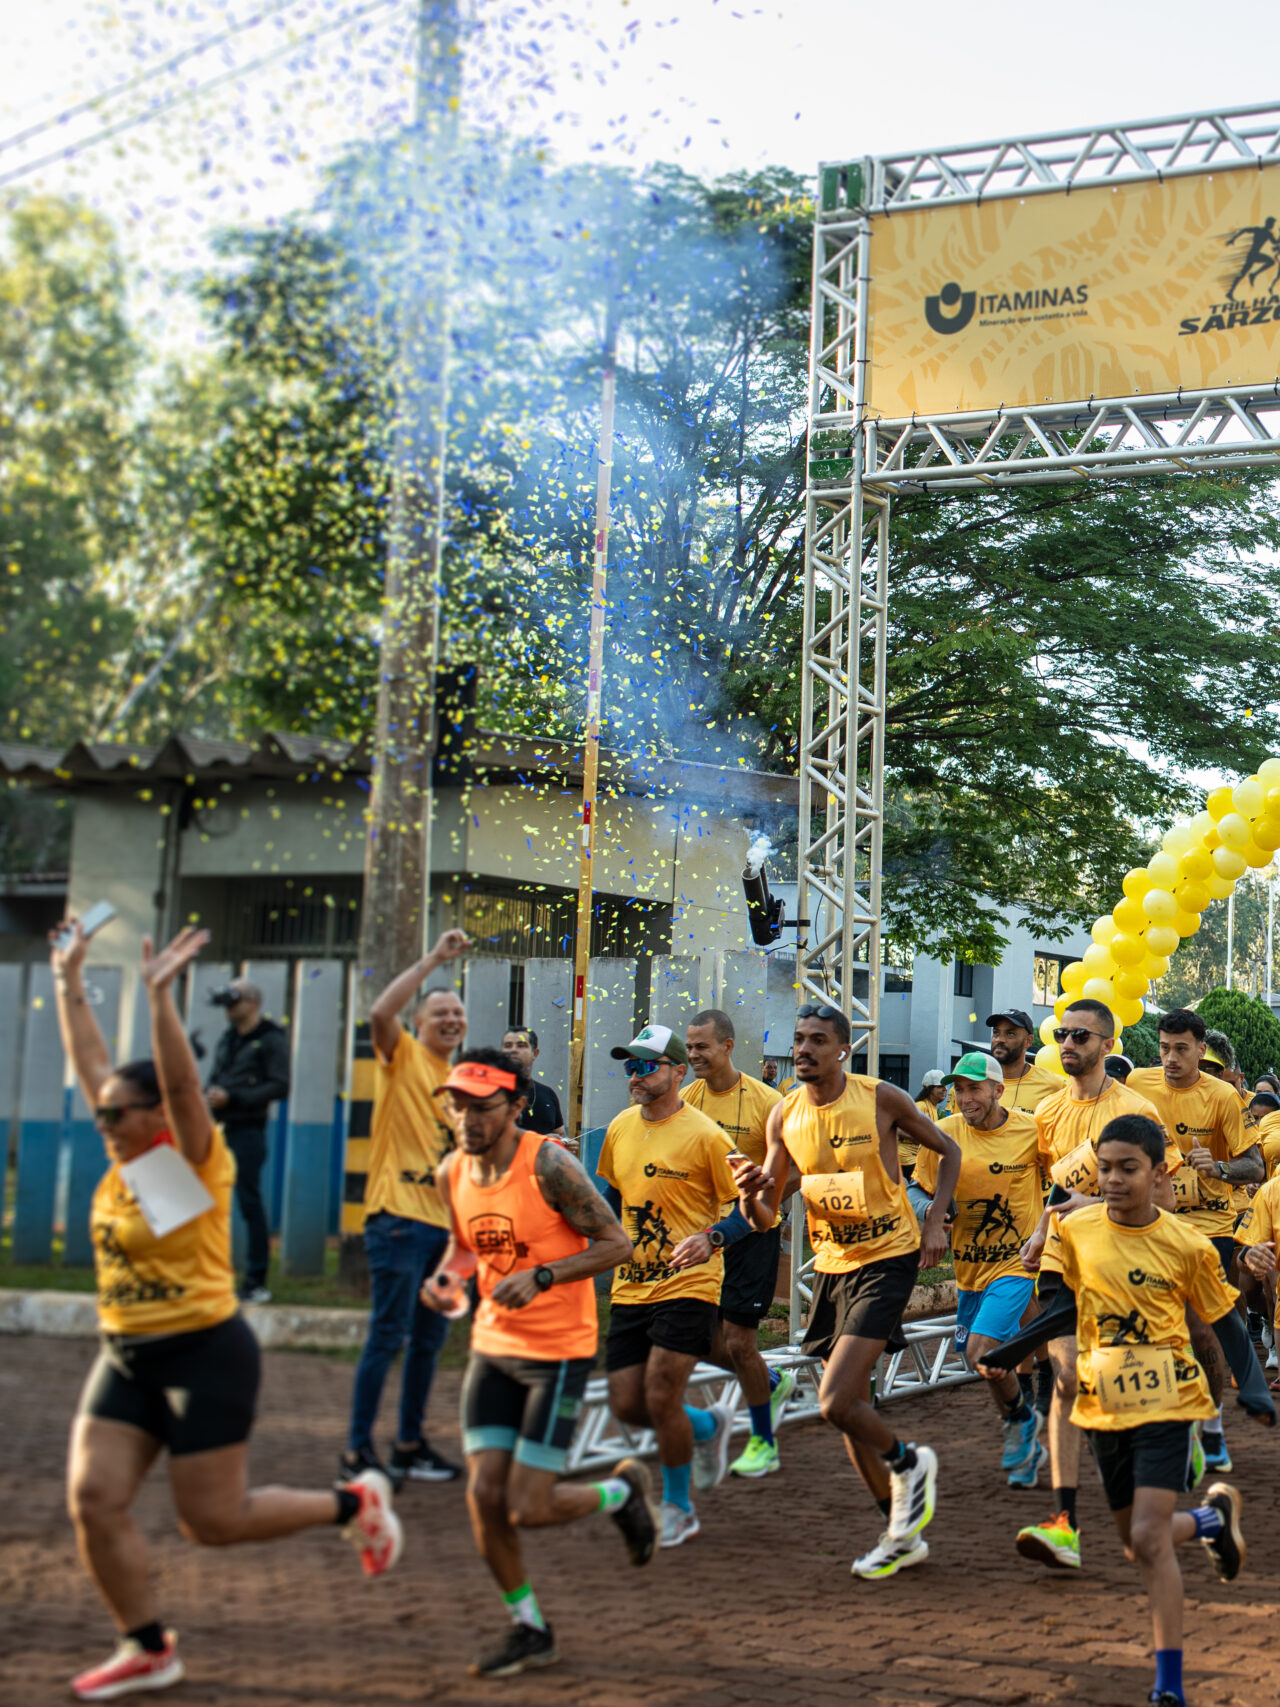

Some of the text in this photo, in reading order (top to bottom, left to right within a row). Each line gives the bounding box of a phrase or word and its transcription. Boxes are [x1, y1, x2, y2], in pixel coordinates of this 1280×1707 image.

[980, 284, 1088, 314] ITAMINAS
[1065, 1163, 1091, 1190] 421
[1173, 1183, 1187, 1196] 21
[819, 1196, 854, 1211] 102
[872, 1214, 890, 1226] DE
[965, 1242, 1016, 1254] TRILHAS
[953, 1249, 1022, 1263] SARZE
[618, 1268, 680, 1283] SARZE
[1114, 1370, 1160, 1393] 113
